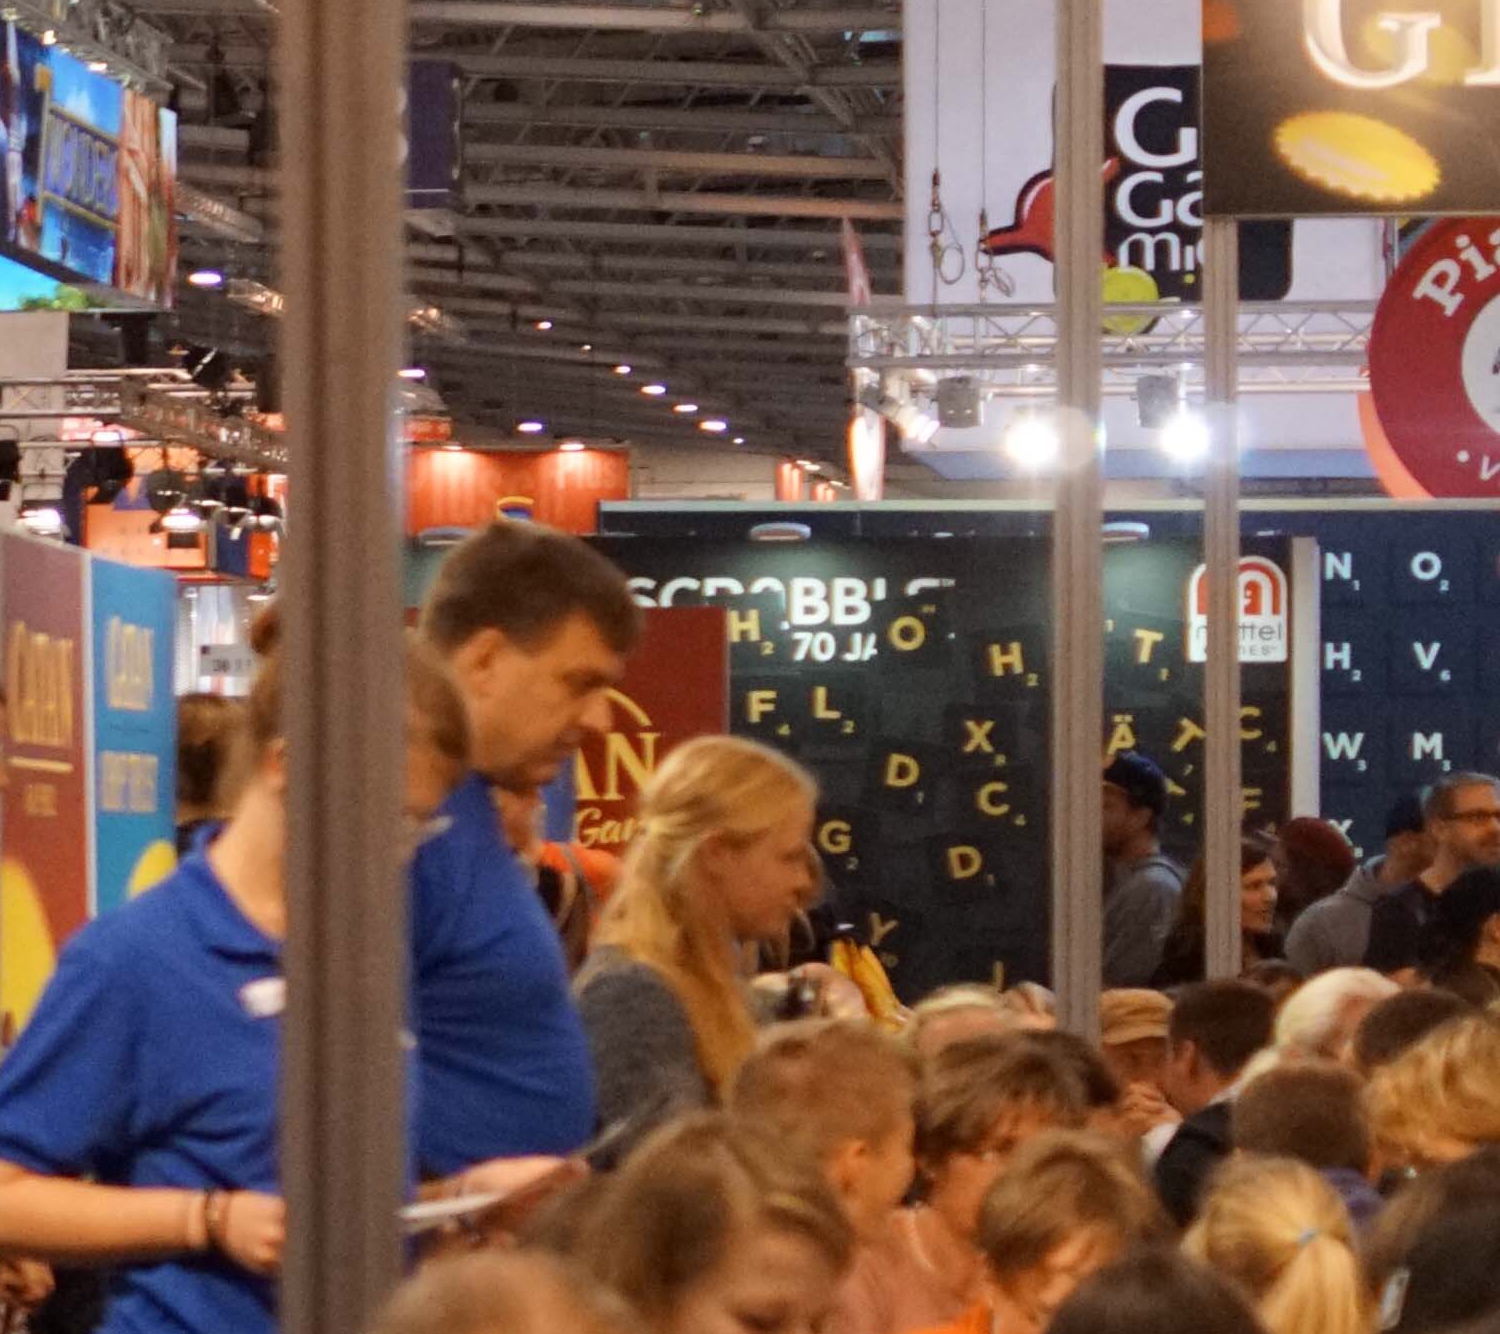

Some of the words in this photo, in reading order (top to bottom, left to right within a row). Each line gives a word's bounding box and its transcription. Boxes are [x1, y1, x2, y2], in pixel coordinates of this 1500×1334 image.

[1325, 553, 1353, 581] N
[1411, 552, 1443, 582] O
[730, 608, 762, 643] H
[888, 615, 927, 652] O
[1195, 622, 1284, 642] ttel
[791, 631, 837, 662] 70
[988, 640, 1026, 677] H
[1134, 629, 1164, 665] T
[1325, 642, 1353, 671] H
[1413, 641, 1442, 671] V
[747, 689, 778, 724] F
[813, 686, 842, 721] L
[962, 719, 996, 755] X
[1322, 731, 1366, 762] W
[1412, 731, 1444, 762] M
[885, 753, 920, 789] D
[977, 782, 1011, 817] C
[818, 820, 853, 855] G
[947, 845, 984, 881] D
